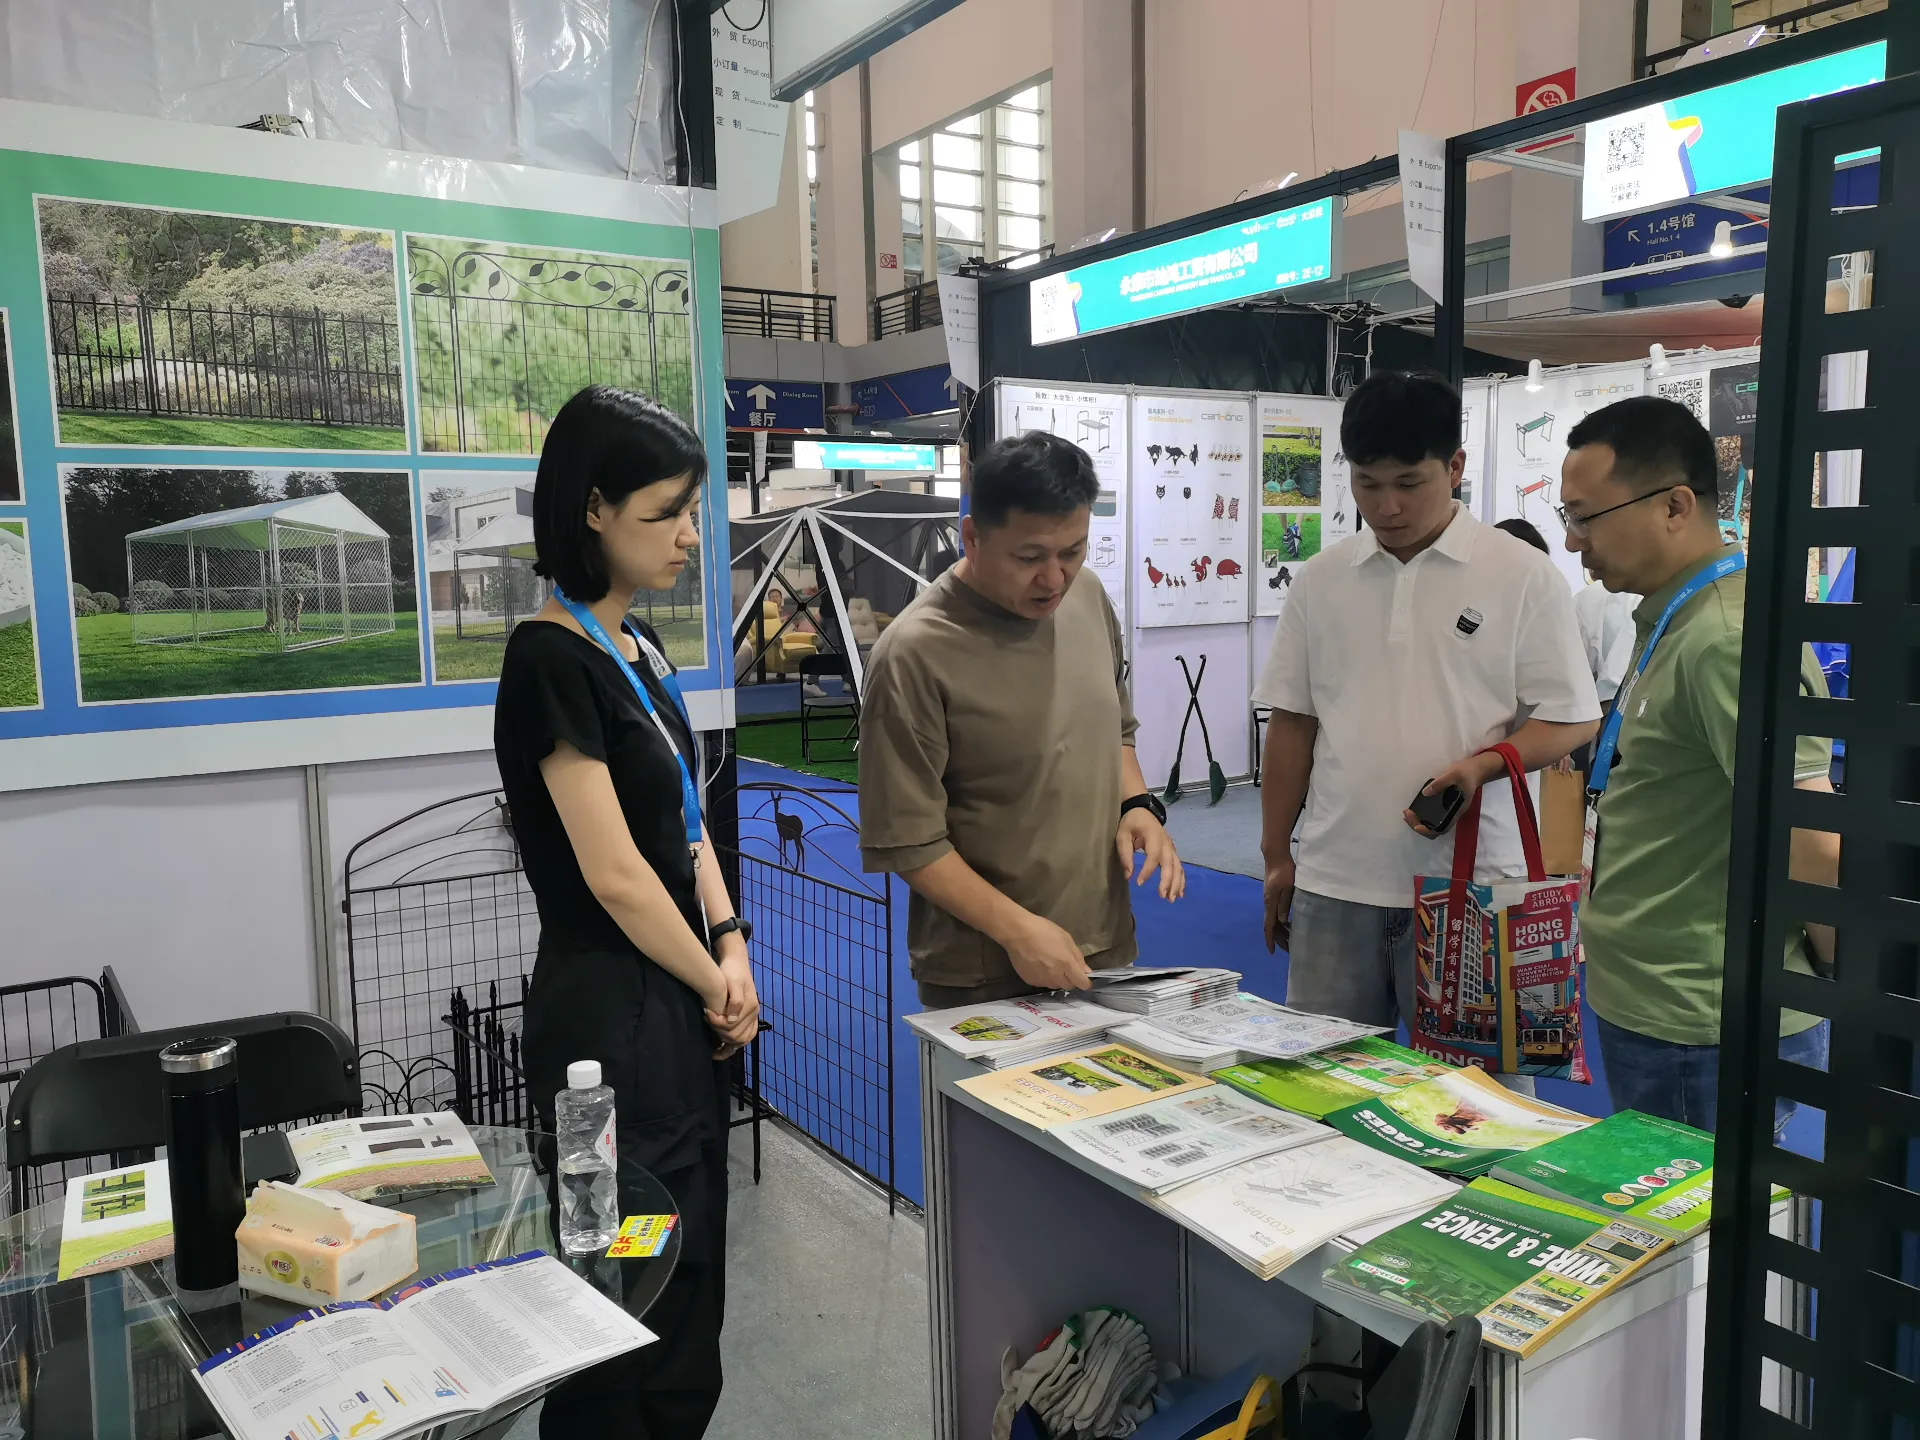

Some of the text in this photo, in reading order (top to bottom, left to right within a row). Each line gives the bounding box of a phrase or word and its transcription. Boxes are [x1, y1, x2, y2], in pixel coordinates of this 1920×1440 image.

[1648, 213, 1696, 234] 1.4号馆
[1647, 236, 1658, 246] Hall
[782, 391, 801, 399] Dining
[801, 391, 818, 399] Room
[748, 411, 777, 427] 餐厅
[1532, 889, 1562, 901] STUDY
[1532, 894, 1571, 908] ABROAD
[1515, 918, 1563, 937] HONG
[1515, 931, 1565, 947] KONG
[1516, 966, 1558, 978] CONVENTION
[1415, 1042, 1485, 1069] HONG
[1012, 1077, 1050, 1095] EDGE
[1047, 1094, 1088, 1114] LAWN
[1358, 1109, 1468, 1158] PET CAGES
[1421, 1210, 1612, 1284] WIRE & FENCE
